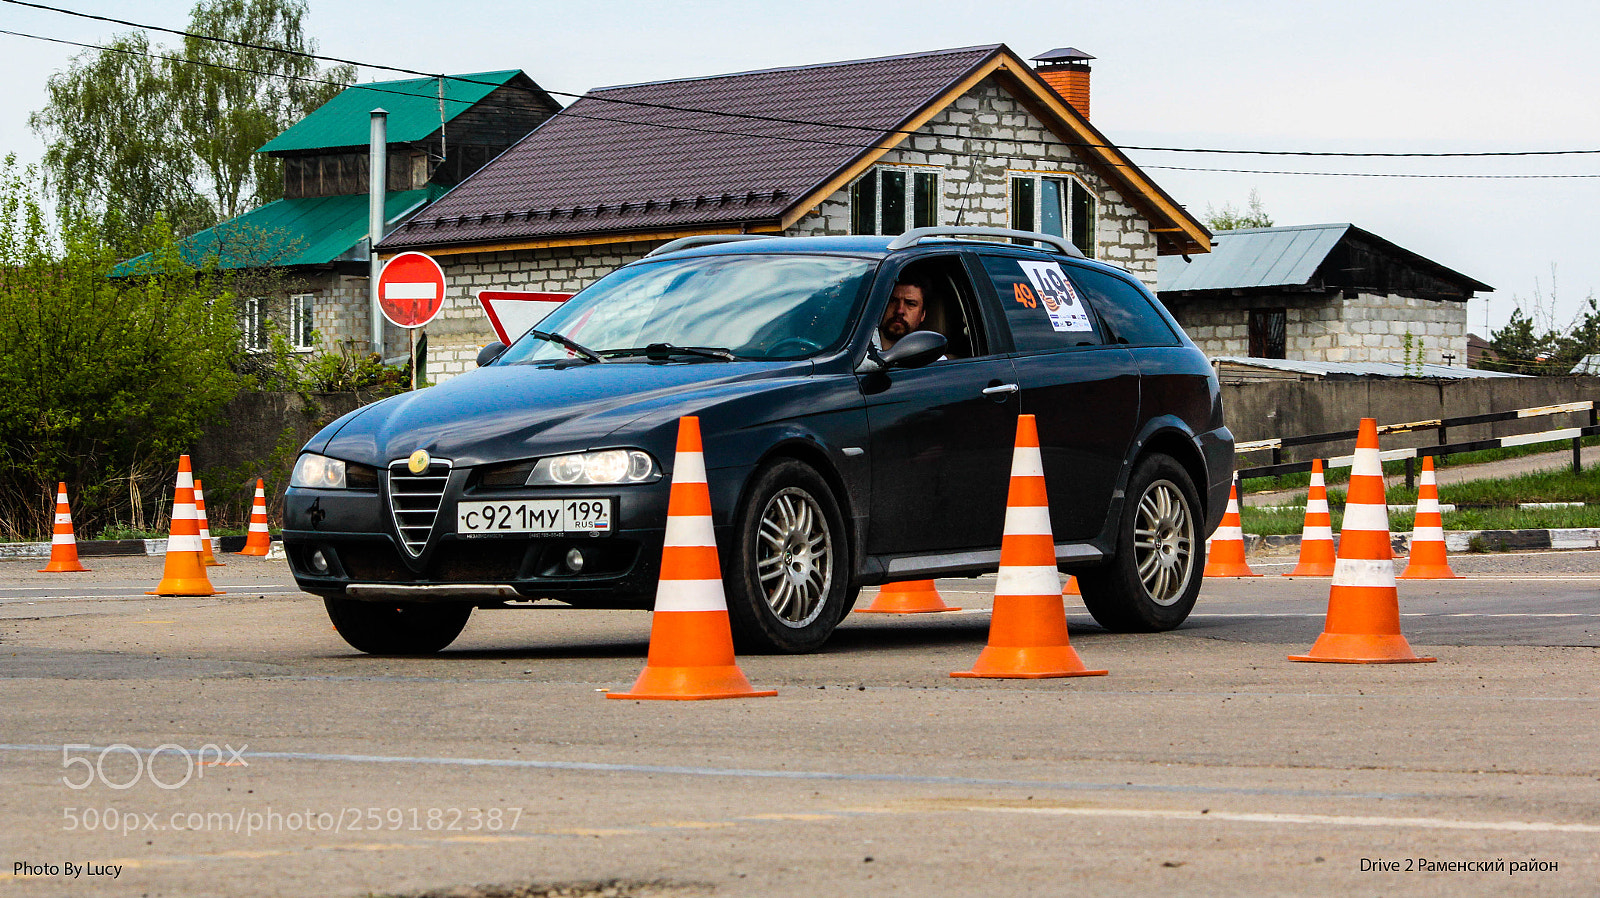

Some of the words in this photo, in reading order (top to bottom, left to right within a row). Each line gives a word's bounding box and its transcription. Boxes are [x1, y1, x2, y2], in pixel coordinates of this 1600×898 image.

[1013, 282, 1037, 309] 49
[1032, 268, 1074, 306] 49
[567, 501, 604, 521] 199
